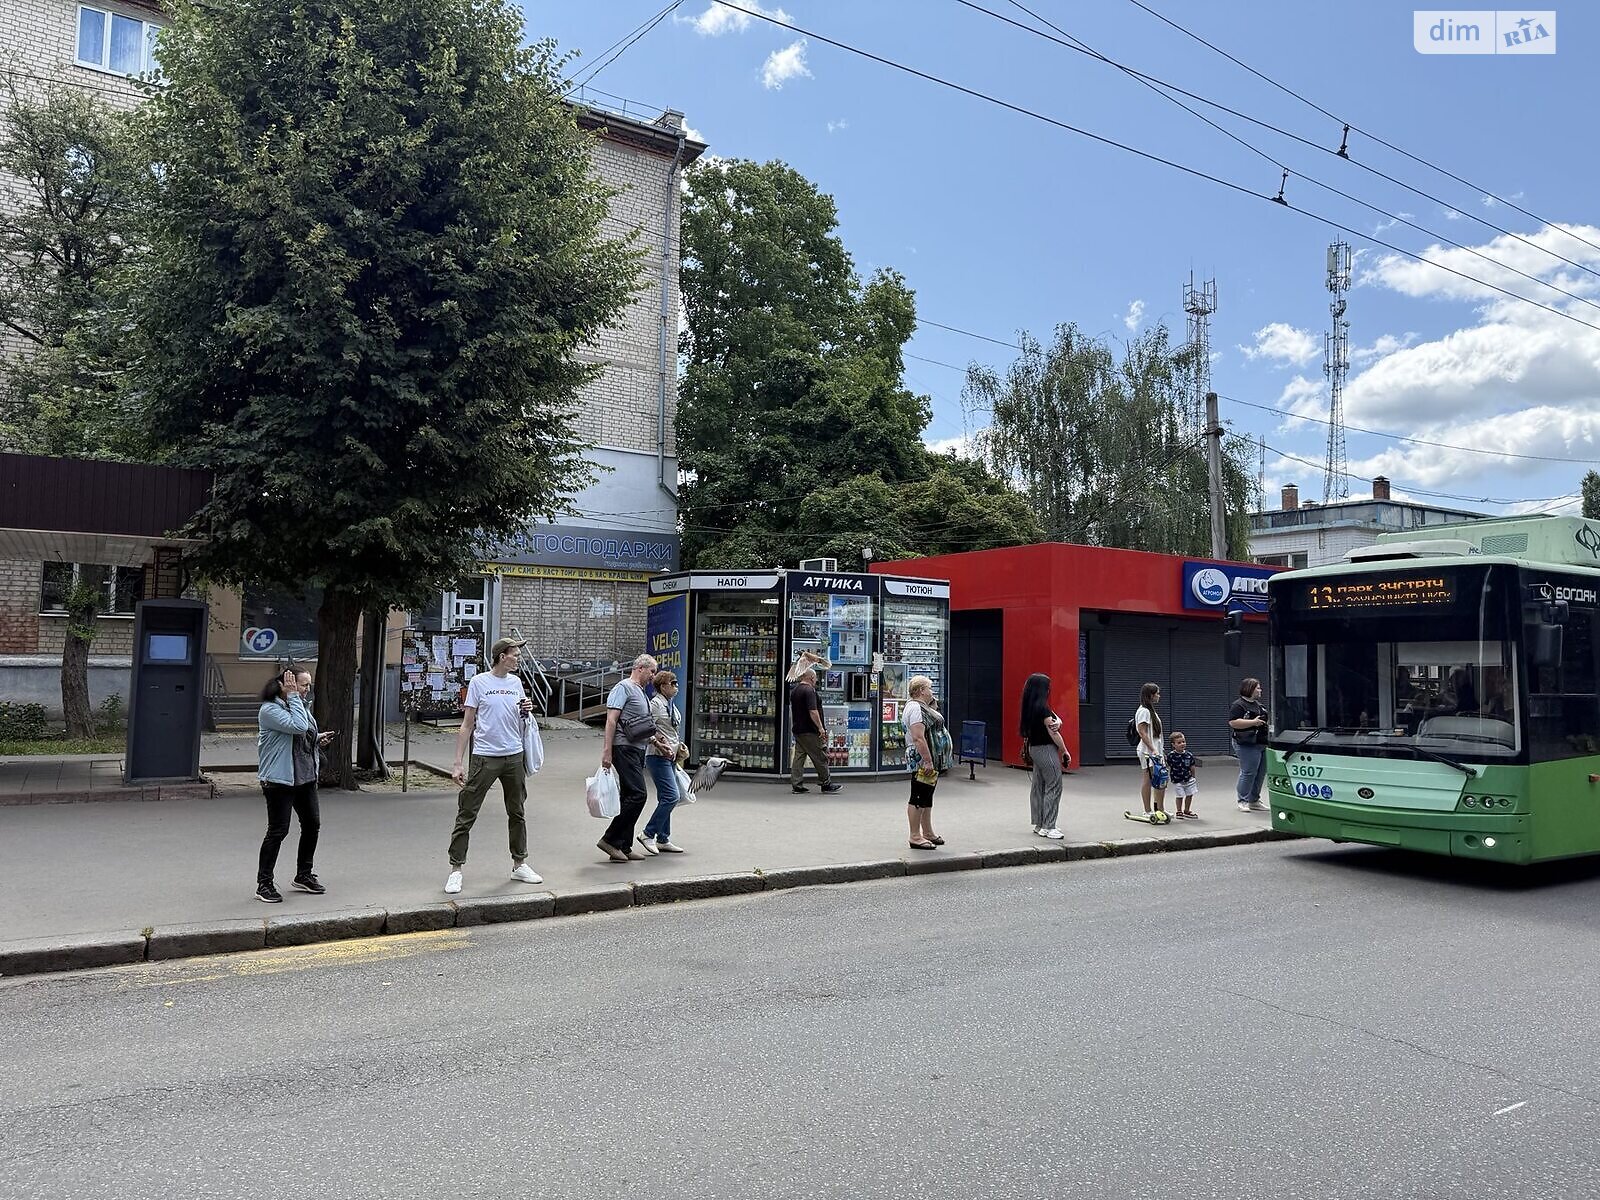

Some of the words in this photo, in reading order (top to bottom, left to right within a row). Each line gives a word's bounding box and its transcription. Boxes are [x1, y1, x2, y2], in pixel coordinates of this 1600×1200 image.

[533, 534, 673, 560] ГОСПОДАРКИ
[717, 576, 748, 587] НАПОЇ
[803, 576, 863, 591] АТТИКА
[905, 584, 933, 595] ТЮТЮН
[1555, 586, 1597, 602] БОГДАН
[1291, 764, 1324, 778] 3607
